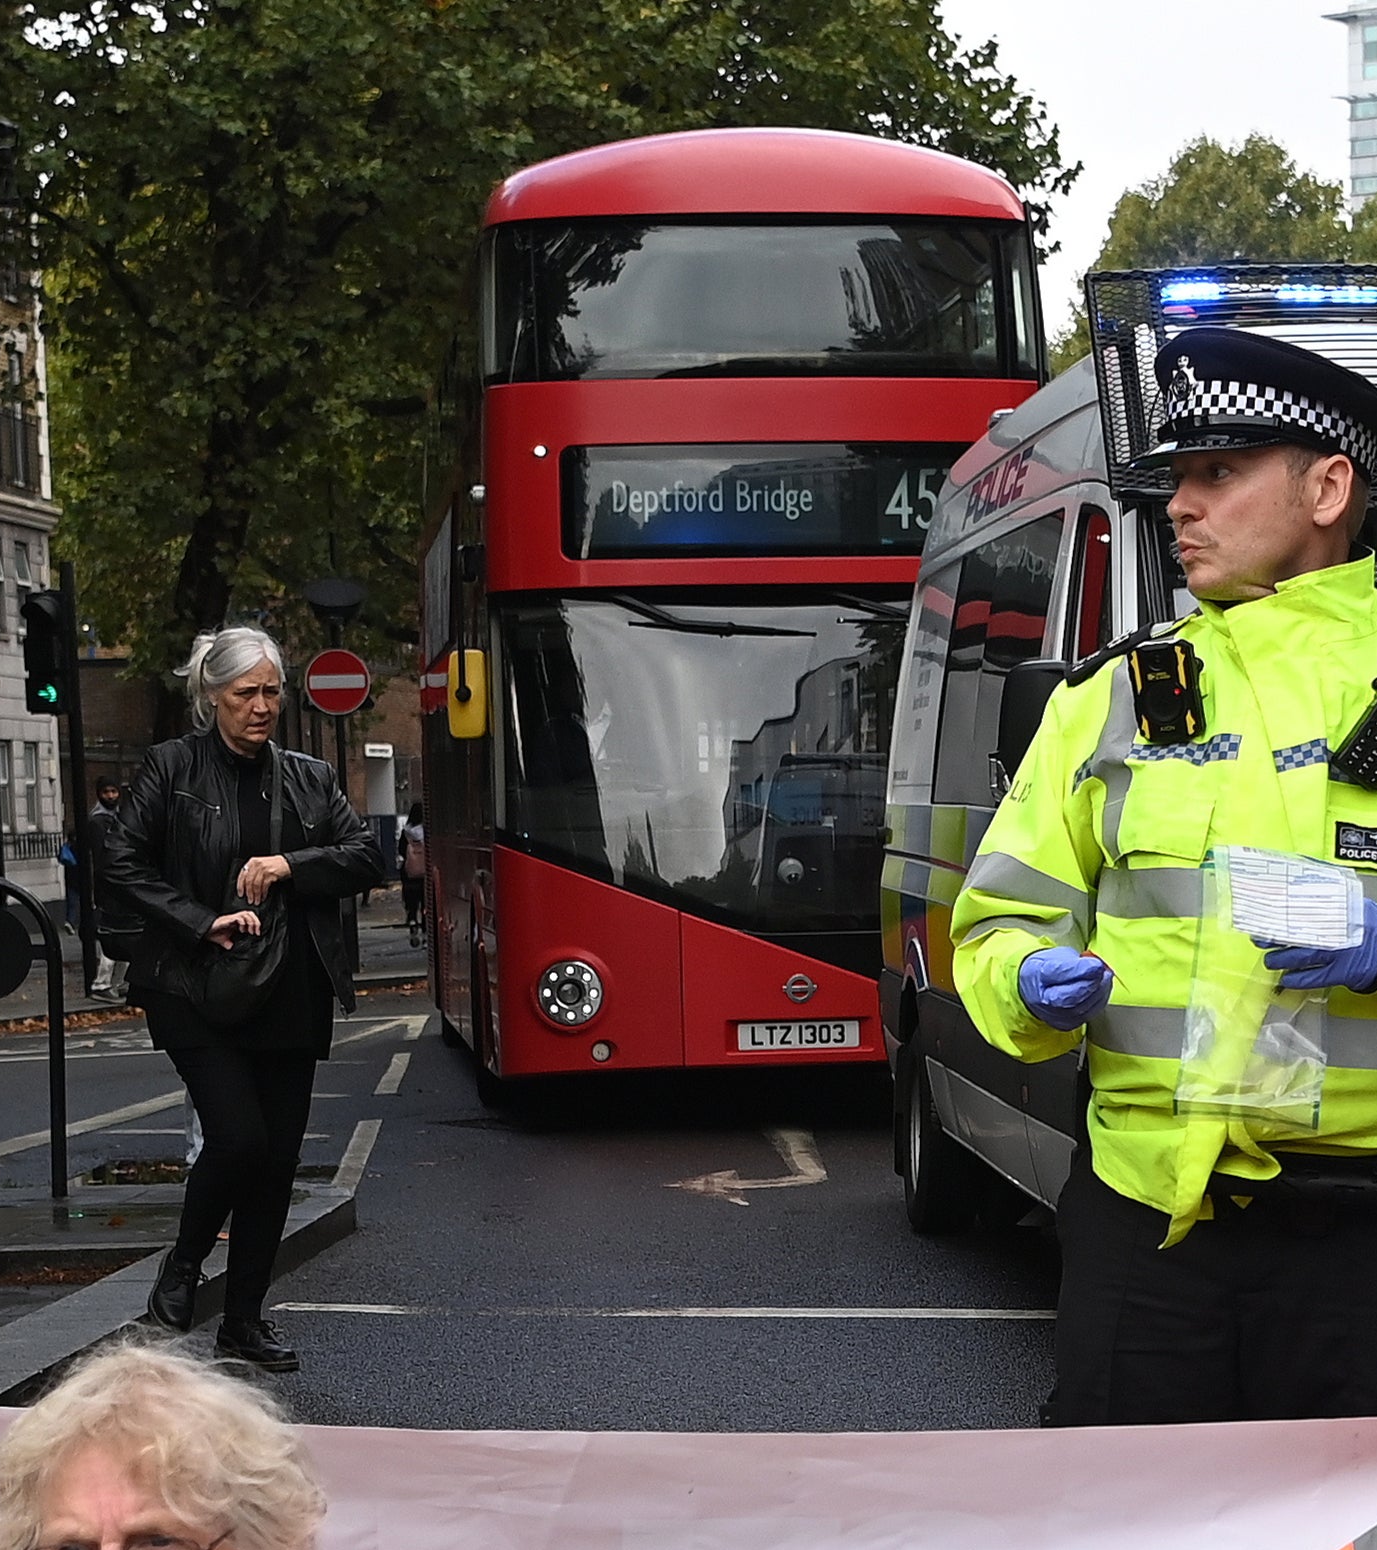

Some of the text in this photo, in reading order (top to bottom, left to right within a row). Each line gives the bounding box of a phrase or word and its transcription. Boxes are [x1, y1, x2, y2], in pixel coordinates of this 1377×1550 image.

[612, 479, 814, 523] Deptford Bridge
[885, 467, 950, 531] 45
[962, 445, 1035, 532] POLICE
[750, 1024, 846, 1046] LTZ 1303
